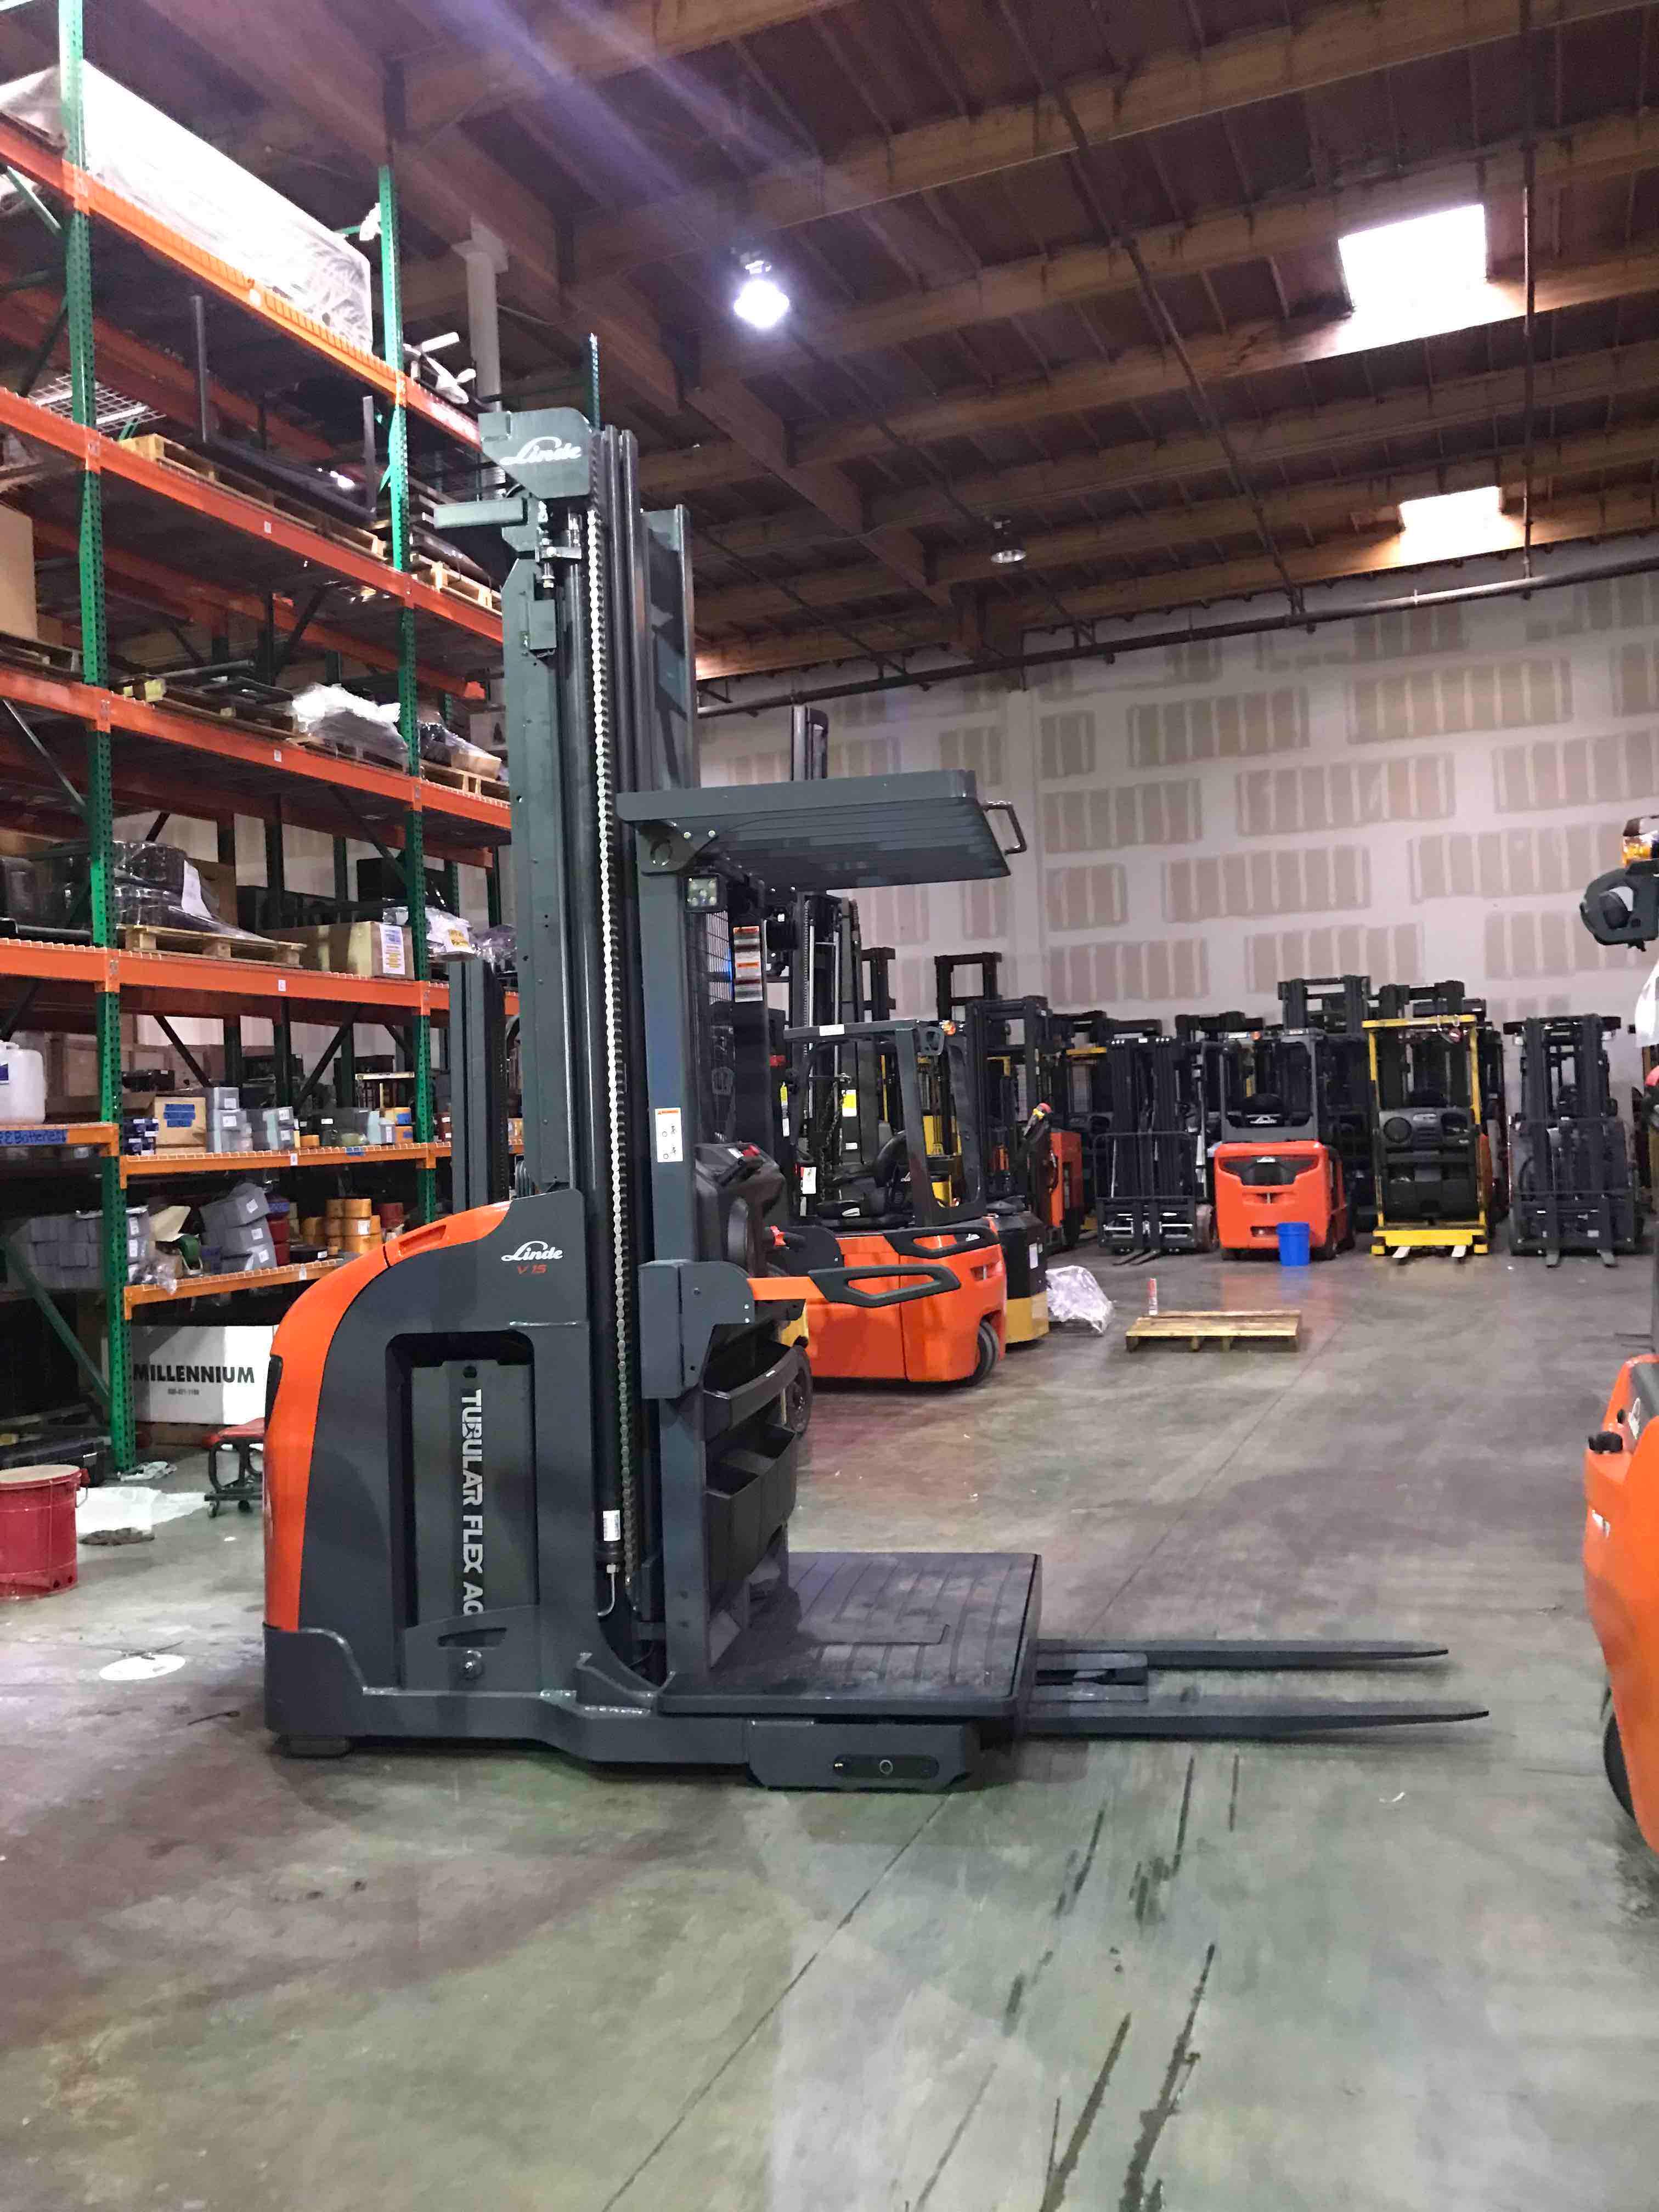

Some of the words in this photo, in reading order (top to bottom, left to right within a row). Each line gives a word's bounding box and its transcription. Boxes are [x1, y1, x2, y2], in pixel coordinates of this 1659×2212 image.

[499, 436, 582, 466] Linde
[501, 1240, 563, 1261] Linde
[133, 1363, 255, 1383] MILLENNIUM
[461, 1389, 483, 1506] TUBULAR
[463, 1515, 483, 1574] FLEX
